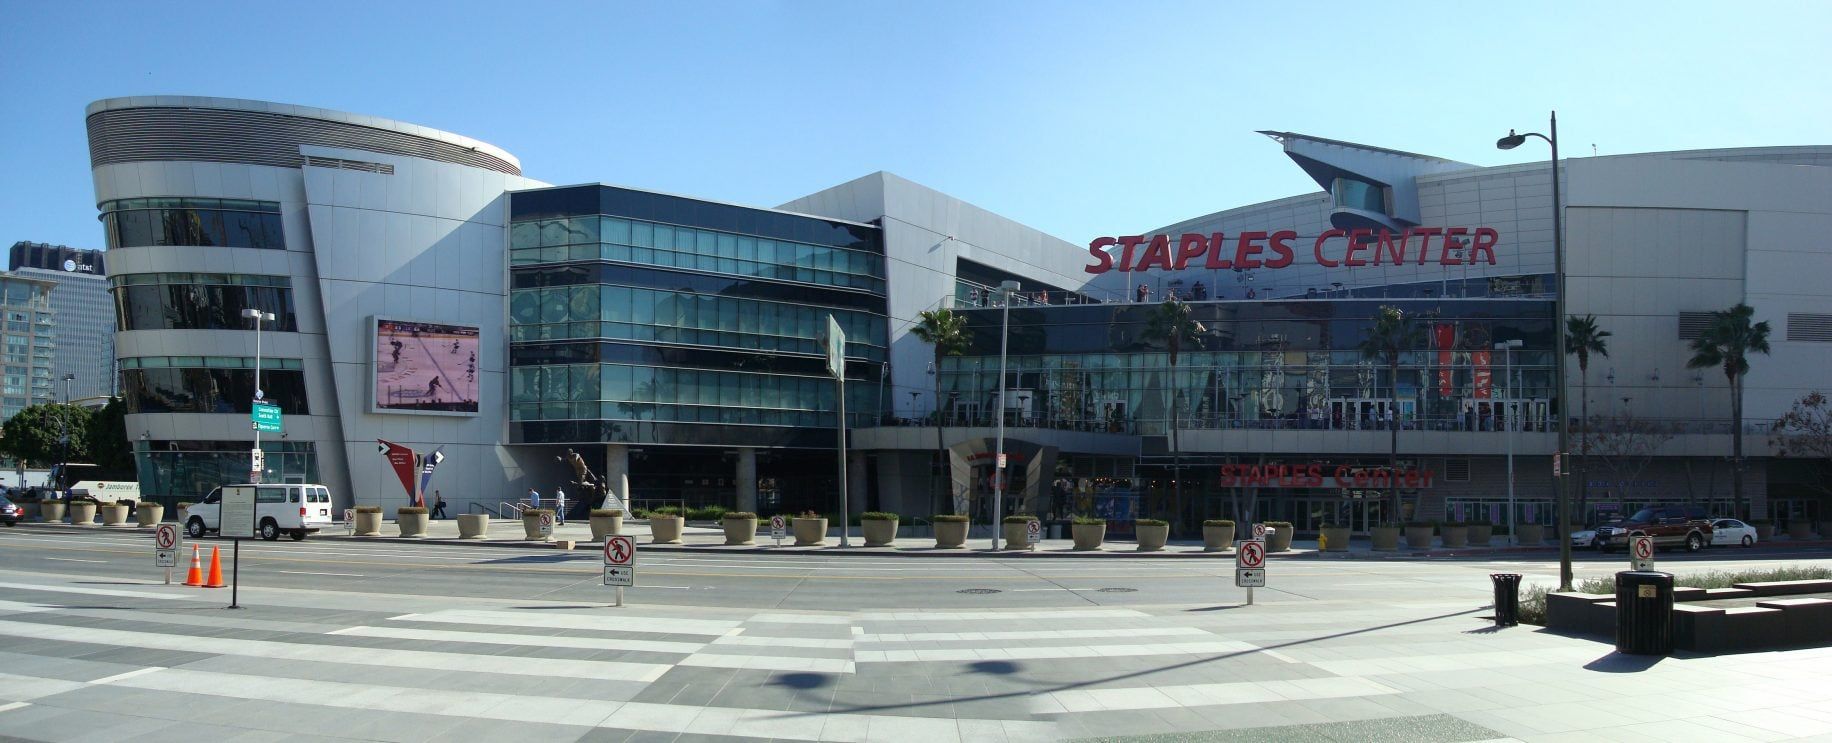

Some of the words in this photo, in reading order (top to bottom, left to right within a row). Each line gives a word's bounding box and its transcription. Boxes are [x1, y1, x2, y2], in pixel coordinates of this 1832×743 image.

[1085, 230, 1297, 274] STAPLES
[1314, 227, 1499, 268] CENTER
[1220, 464, 1323, 487] STAPLES
[1334, 464, 1436, 488] Center
